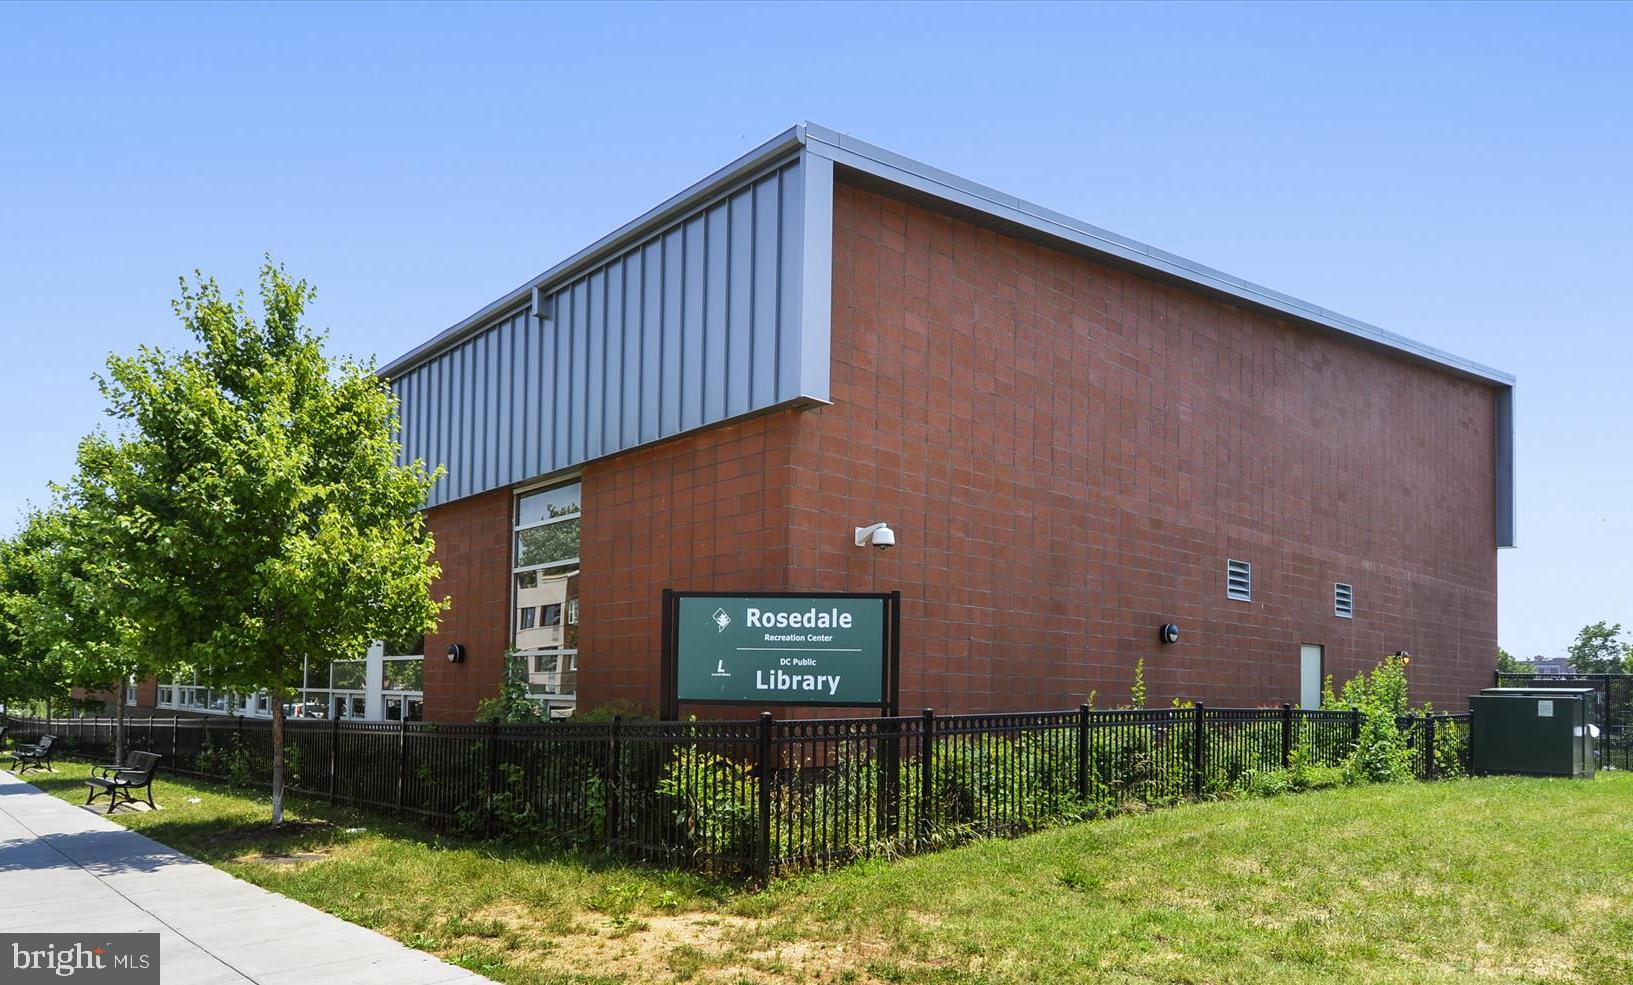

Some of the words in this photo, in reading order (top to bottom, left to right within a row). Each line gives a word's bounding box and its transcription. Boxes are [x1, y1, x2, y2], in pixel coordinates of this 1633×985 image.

[746, 608, 853, 628] Rosedale
[764, 633, 806, 642] Recreation
[807, 634, 833, 642] Center
[780, 658, 792, 666] DC
[793, 658, 817, 667] Public
[756, 670, 841, 695] Library
